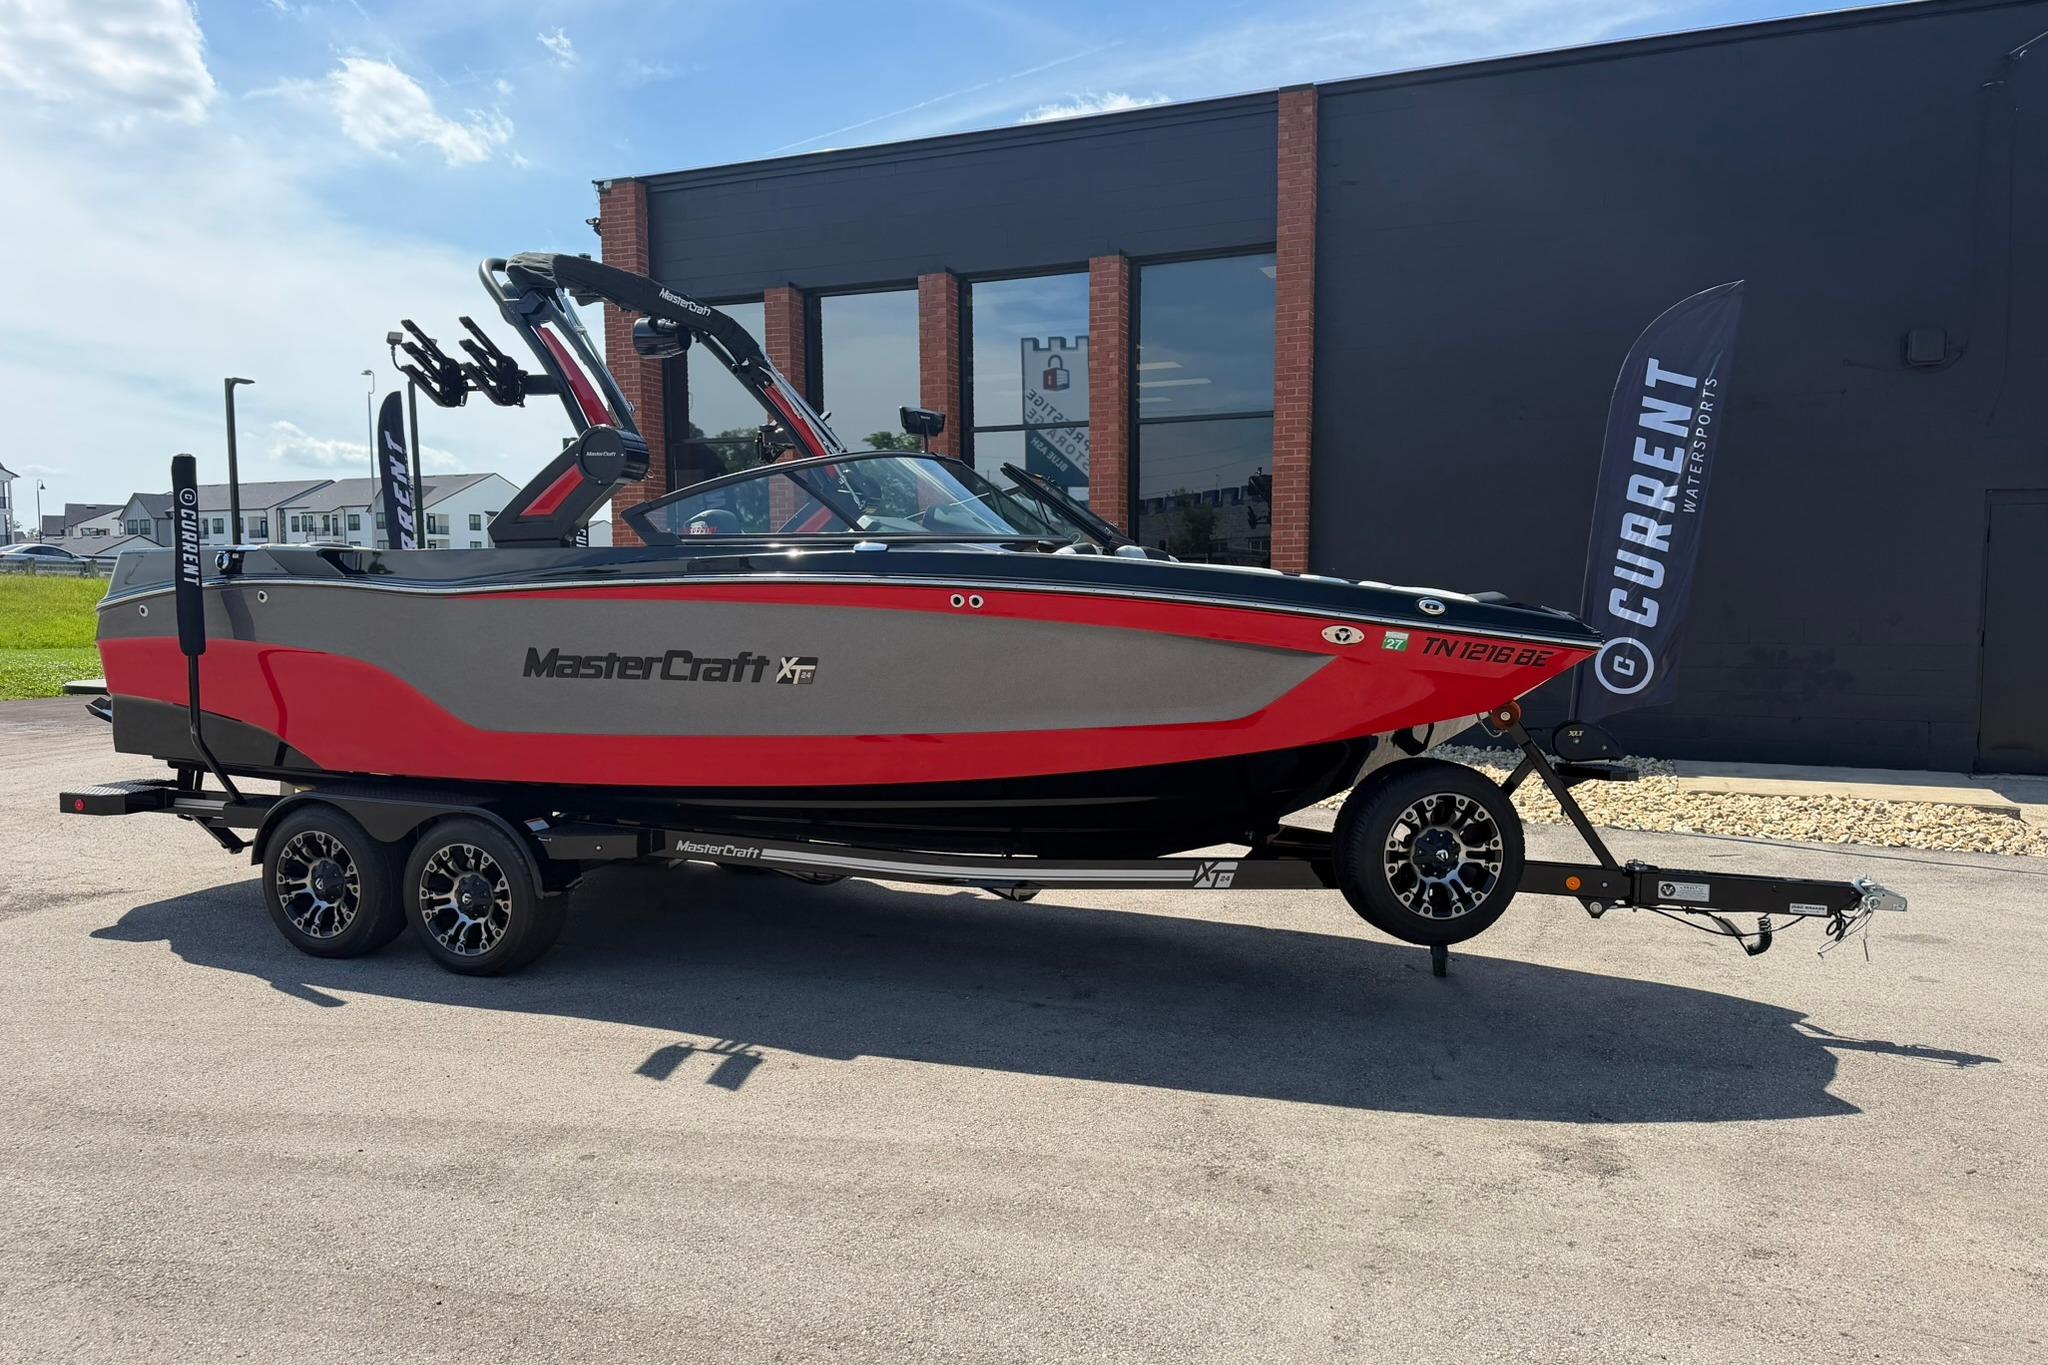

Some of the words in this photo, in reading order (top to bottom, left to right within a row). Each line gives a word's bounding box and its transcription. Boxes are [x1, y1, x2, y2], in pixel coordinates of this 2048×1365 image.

[659, 287, 711, 317] MasterCraft
[1684, 377, 1718, 513] WATERSPORTS
[384, 430, 416, 550] RRENT
[1608, 357, 1698, 628] CURRENT
[180, 508, 200, 586] CURRENT
[1385, 638, 1404, 650] 27
[1422, 636, 1458, 657] TN
[1459, 641, 1516, 664] 1216
[1514, 648, 1554, 667] BE
[522, 647, 770, 683] MasterCraft
[676, 839, 760, 859] MasterCraft
